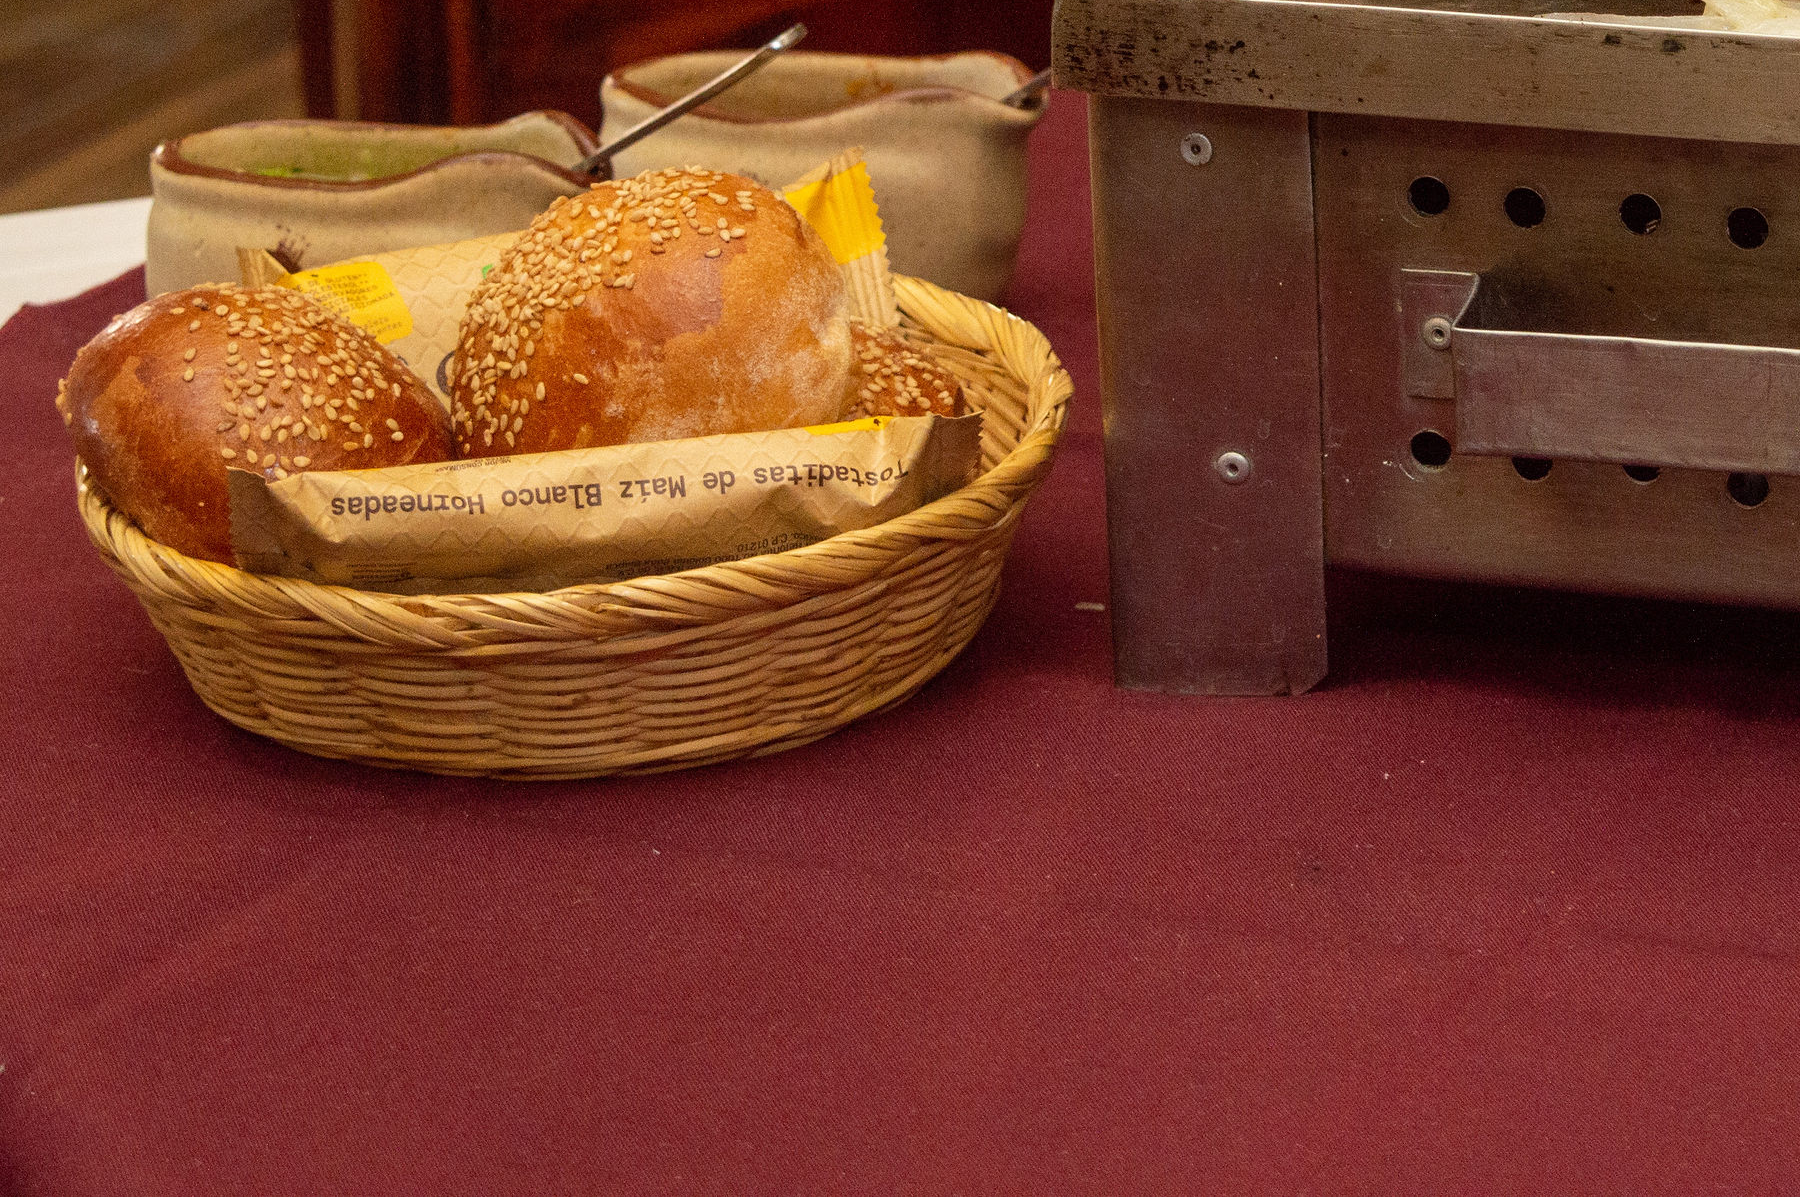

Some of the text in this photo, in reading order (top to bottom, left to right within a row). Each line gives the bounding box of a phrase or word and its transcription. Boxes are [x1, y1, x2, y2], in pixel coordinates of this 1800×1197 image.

[331, 458, 909, 521] Tostaditas de Maíz Blanco Horneadas
